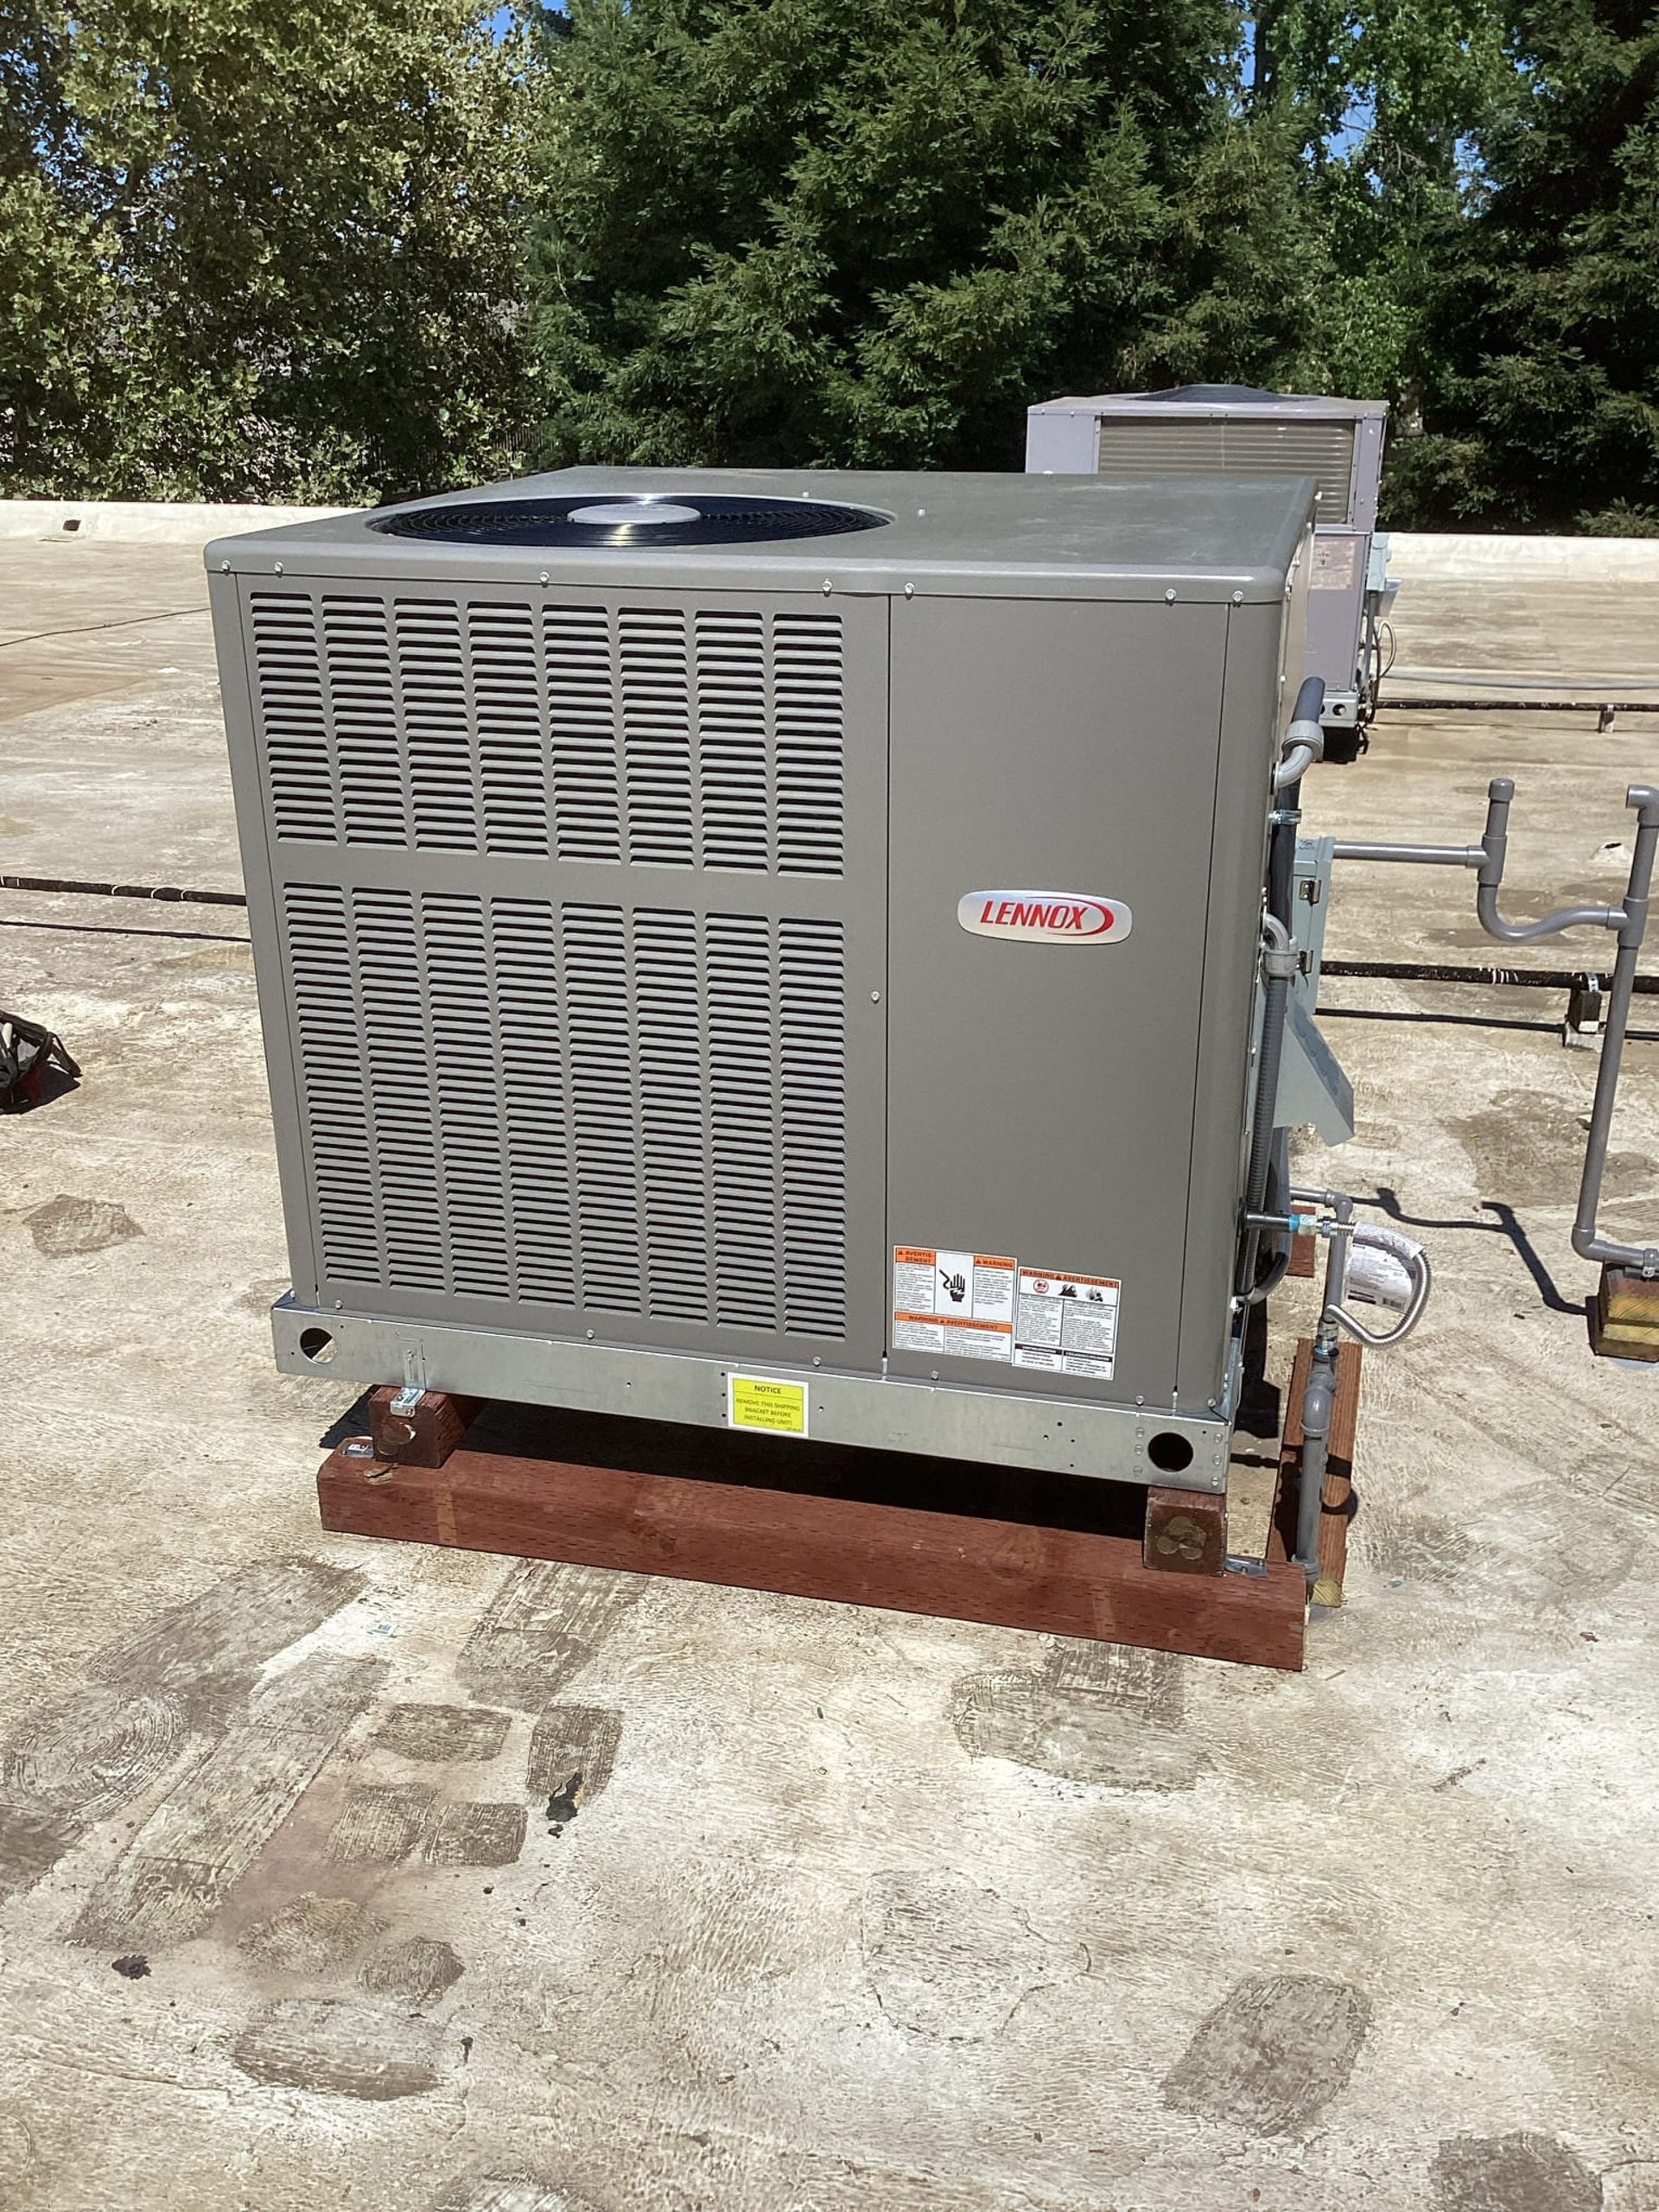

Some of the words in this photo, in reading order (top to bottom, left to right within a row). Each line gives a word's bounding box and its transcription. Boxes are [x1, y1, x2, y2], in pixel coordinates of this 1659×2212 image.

[980, 900, 1090, 930] LENNOX
[982, 1260, 1014, 1268] WARNING
[908, 1315, 939, 1324] WARNING
[946, 1319, 999, 1330] AVERTISSEMENT
[754, 1385, 782, 1394] NOTICE
[745, 1407, 769, 1415] BRACKET
[744, 1414, 776, 1424] INSTALLING
